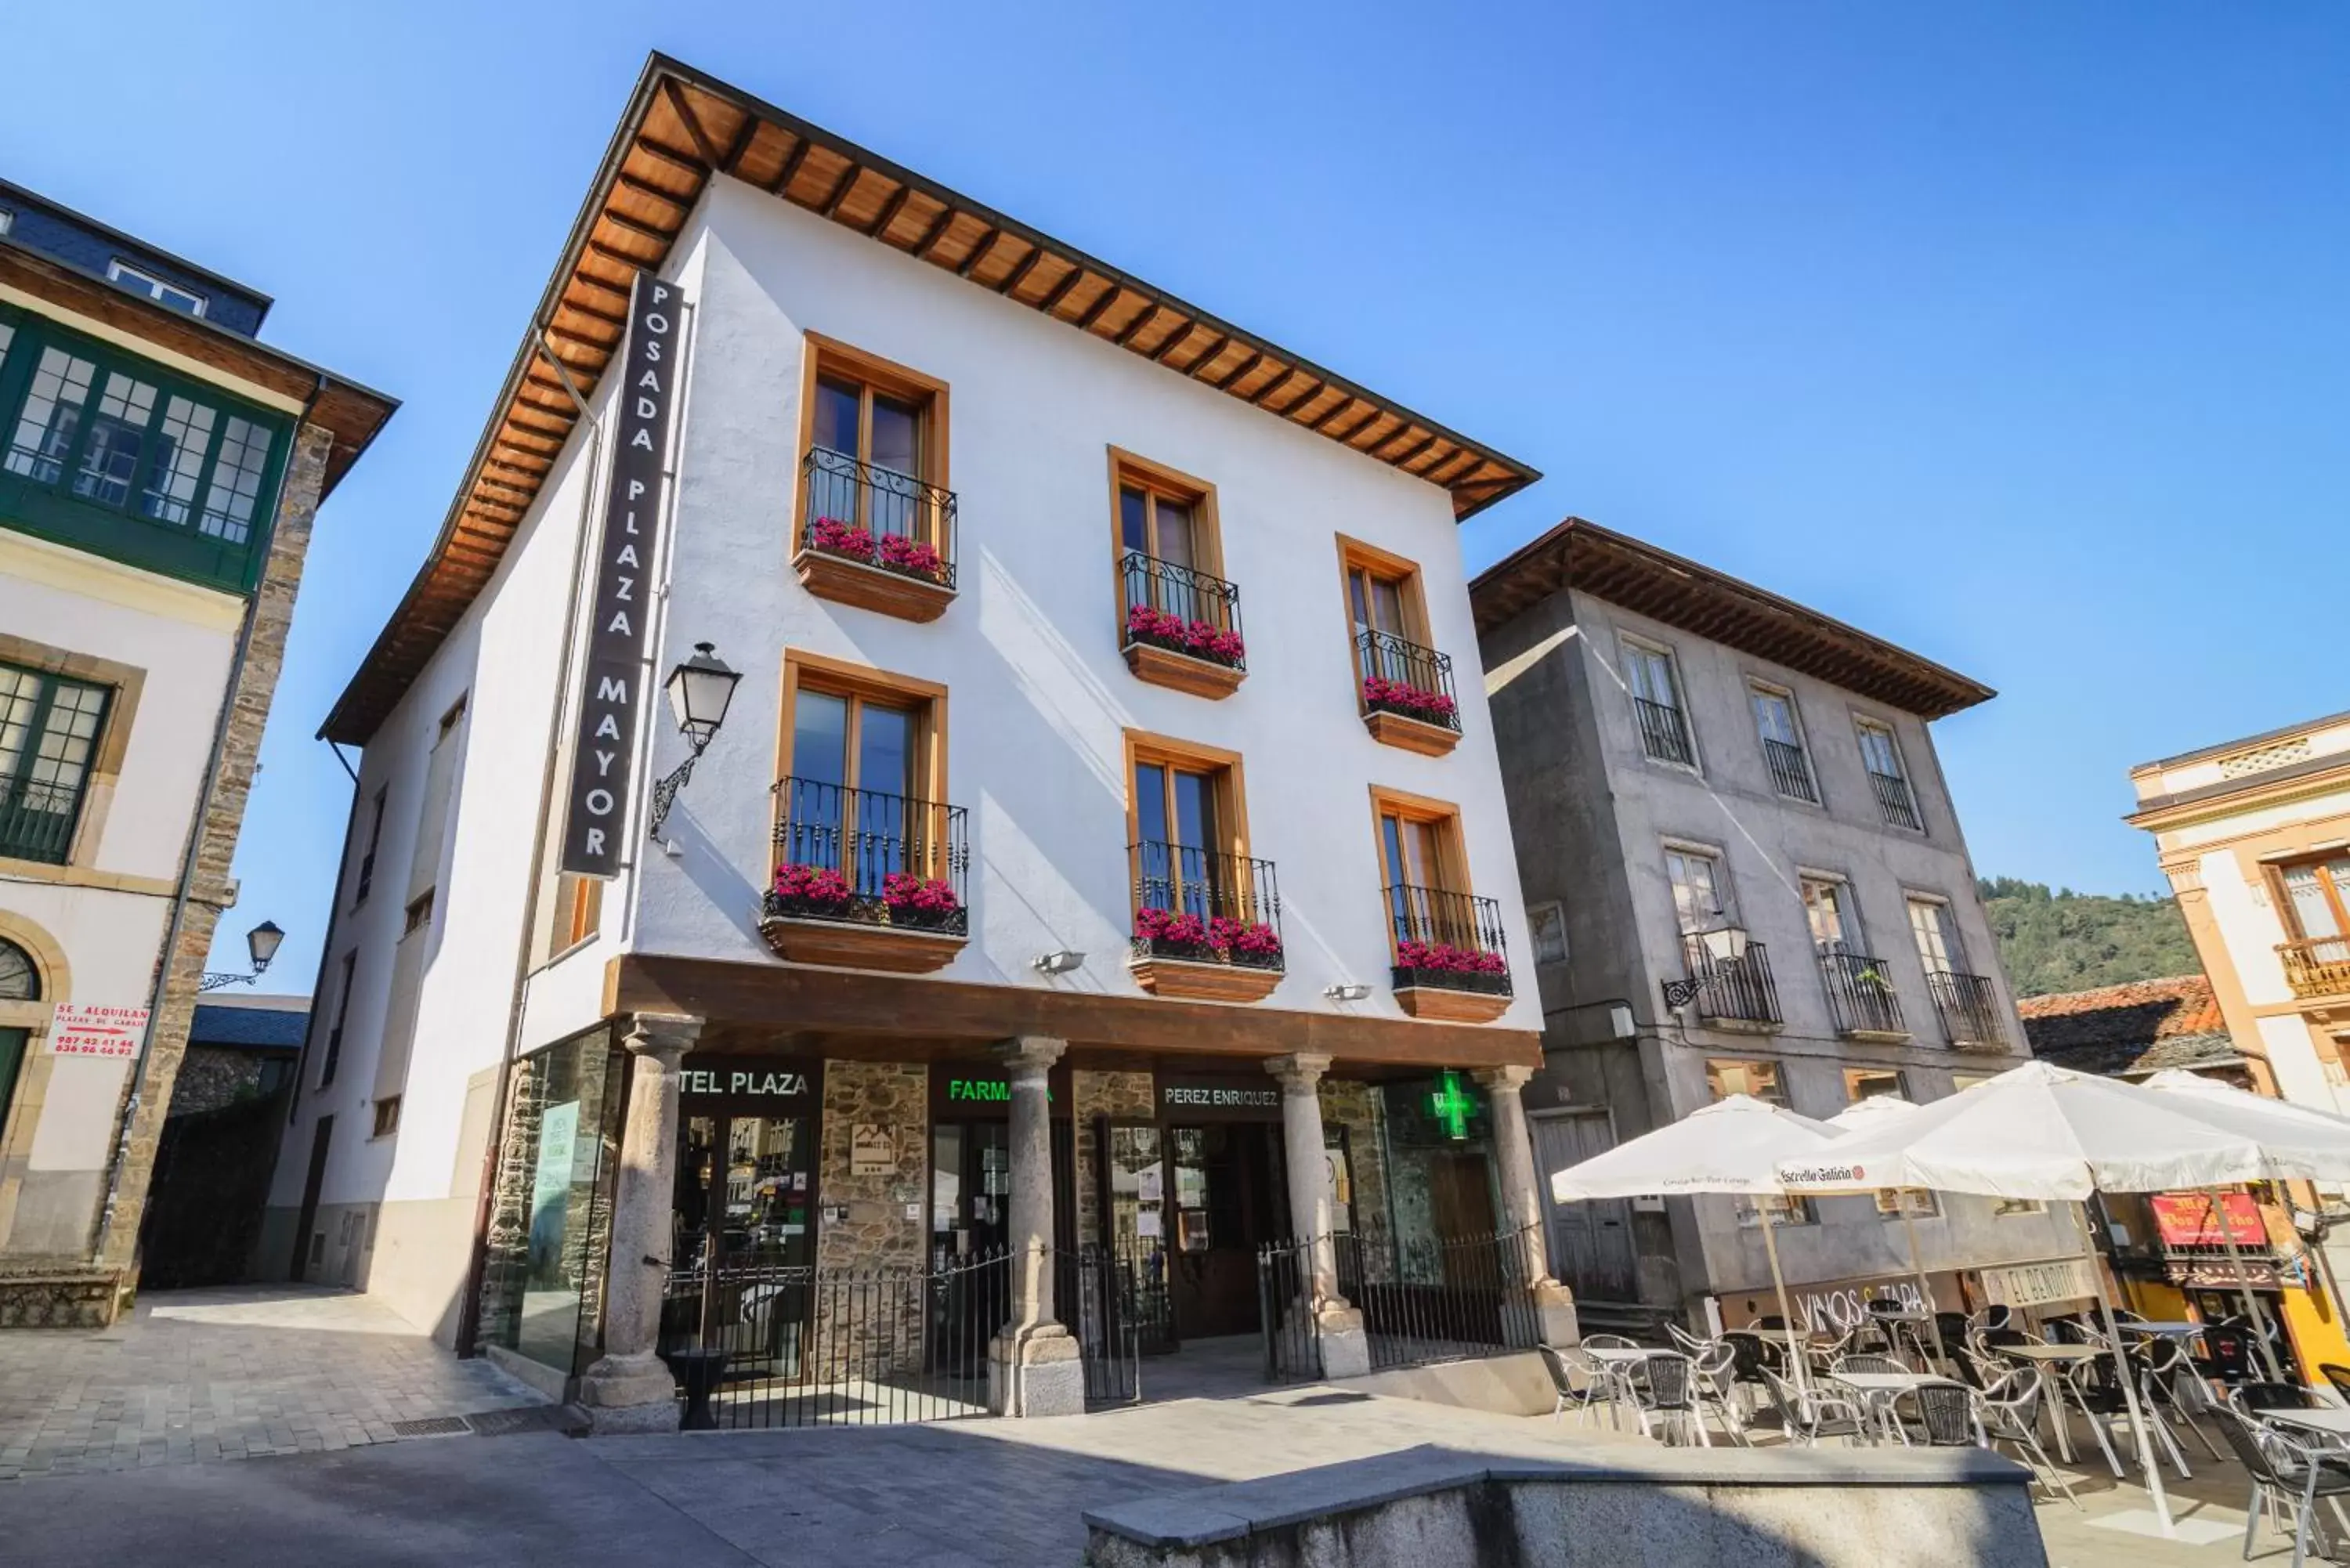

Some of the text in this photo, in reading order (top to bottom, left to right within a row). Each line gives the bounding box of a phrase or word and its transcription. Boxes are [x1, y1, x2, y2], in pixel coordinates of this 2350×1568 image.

[585, 284, 668, 856] POSADA PLAZA MAYOR
[85, 1006, 149, 1018] ALQUILAN
[679, 1071, 808, 1095] TEL PLAZA
[1165, 1088, 1278, 1106] PEREZ ENRIQUEZ
[1817, 1166, 1851, 1182] Galicia
[2008, 1265, 2078, 1303] EL BENDITO
[1795, 1288, 1863, 1332] VINOS
